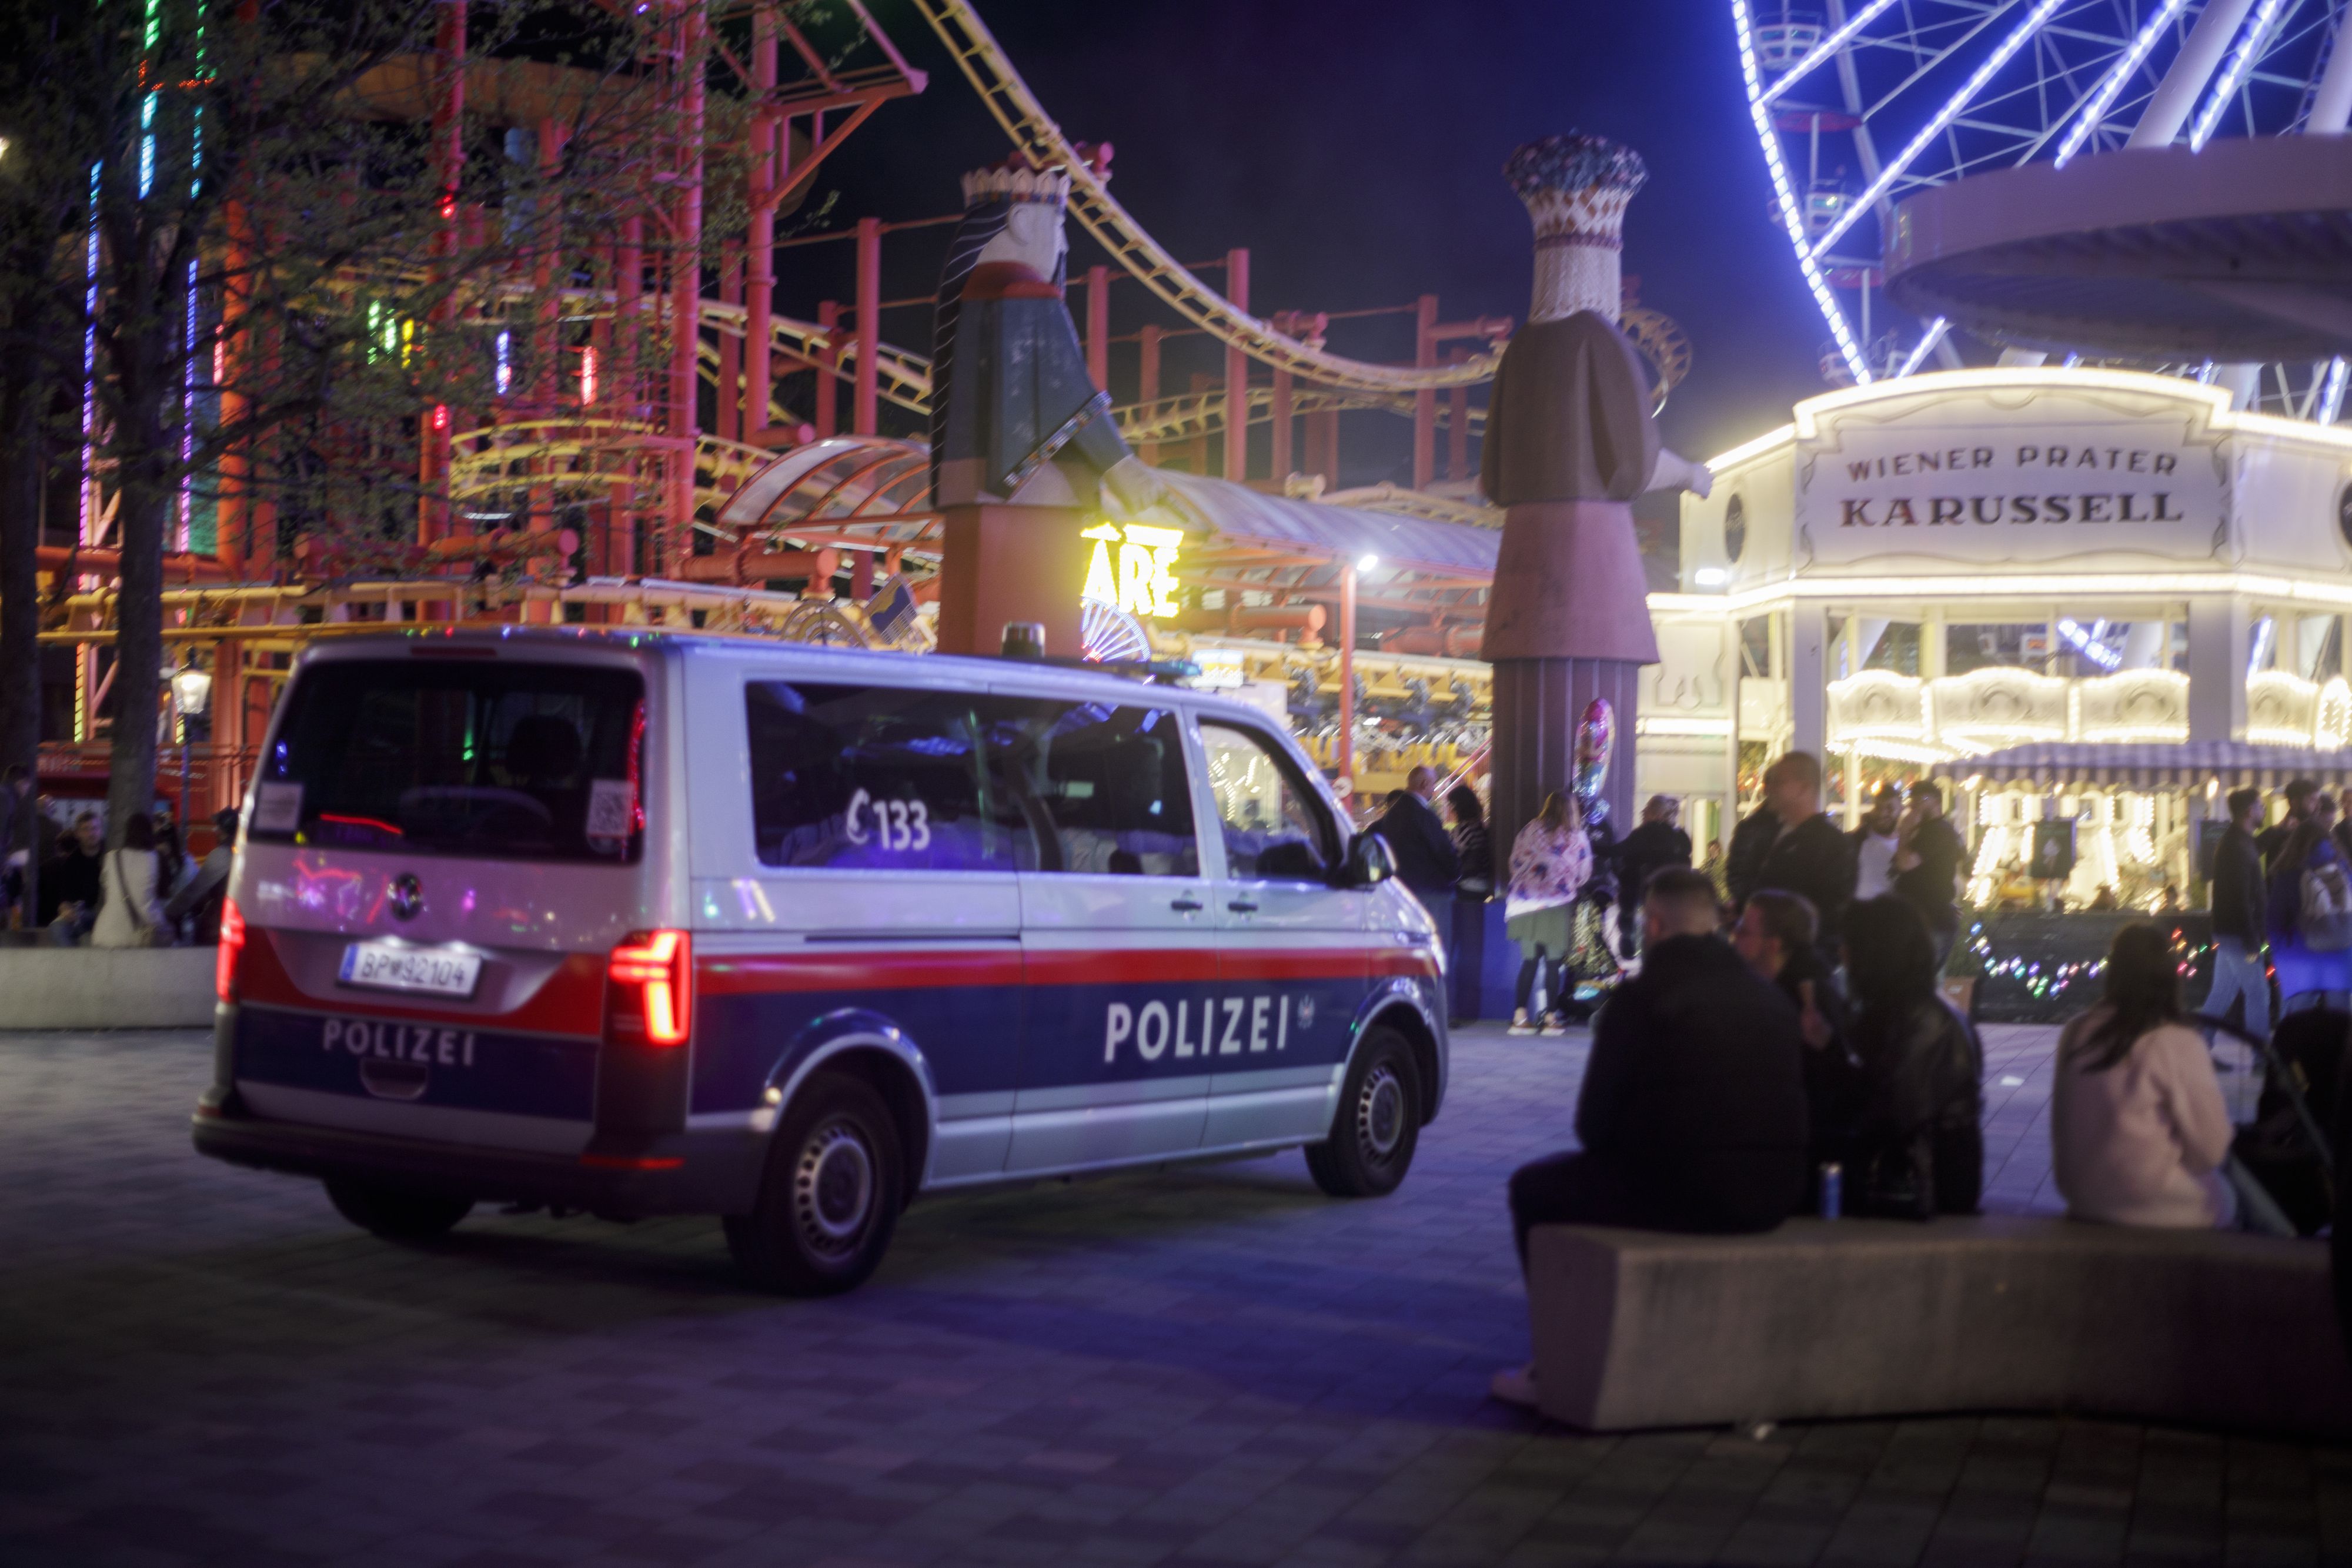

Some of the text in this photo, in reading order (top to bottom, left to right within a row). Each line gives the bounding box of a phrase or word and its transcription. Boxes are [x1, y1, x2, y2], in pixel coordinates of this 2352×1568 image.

[1846, 444, 2177, 482] WIENER PRATER
[1839, 492, 2184, 527] KARUSSELL
[873, 800, 930, 850] 133
[323, 1019, 475, 1066] POLIZEI
[1104, 995, 1288, 1064] POLIZEI
